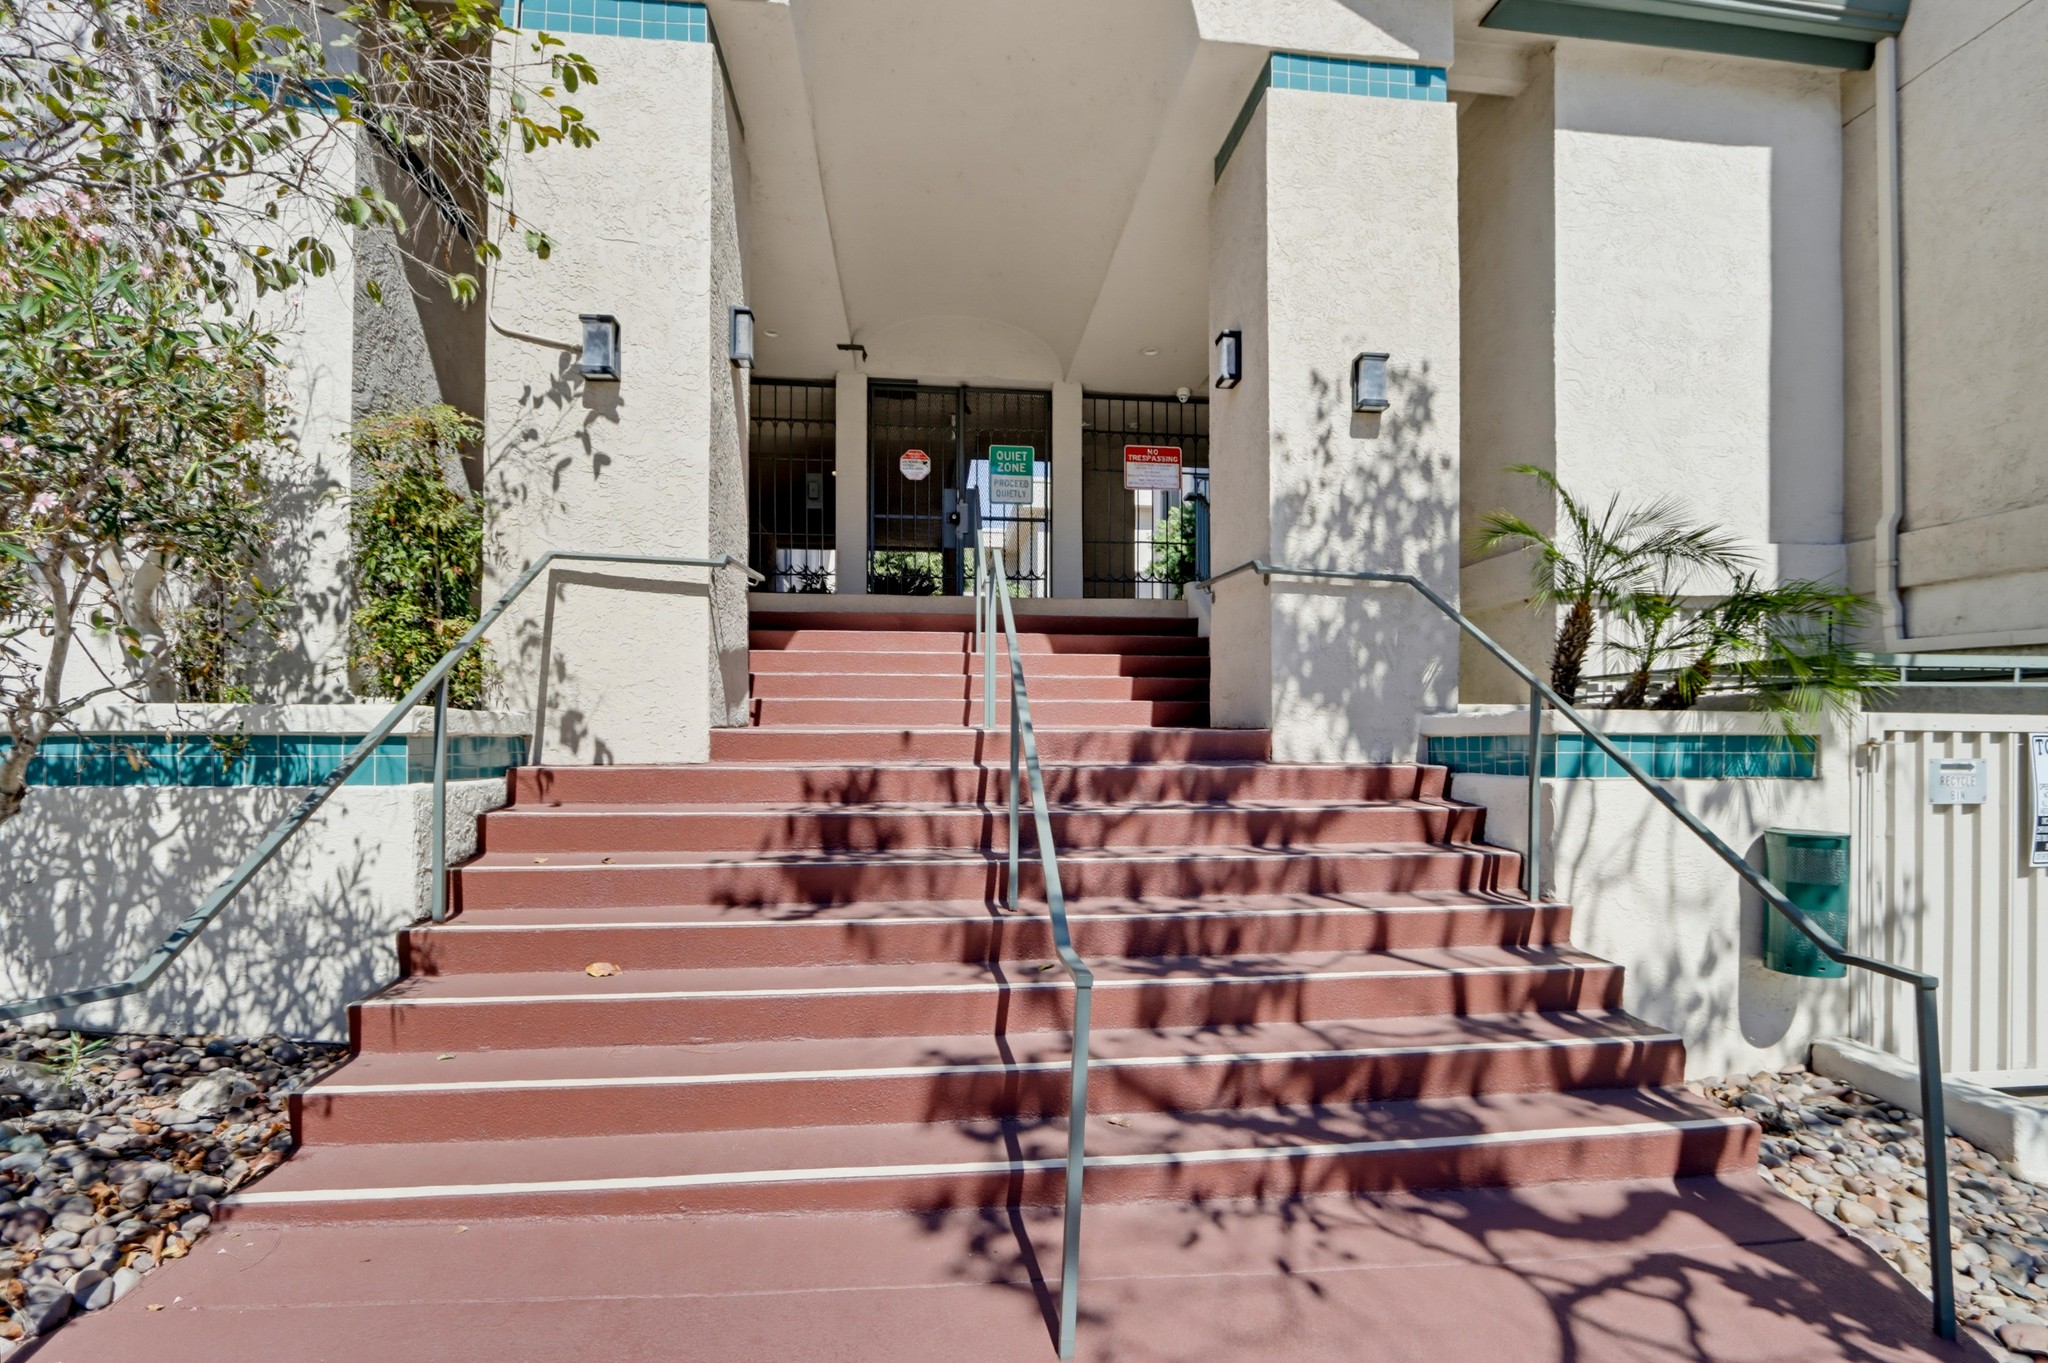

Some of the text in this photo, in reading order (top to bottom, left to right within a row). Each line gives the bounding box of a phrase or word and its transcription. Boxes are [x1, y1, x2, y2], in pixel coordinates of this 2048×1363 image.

[996, 450, 1028, 461] QUIET
[1147, 448, 1159, 456] NO
[1127, 454, 1179, 463] TRESPASSING
[997, 462, 1027, 473] ZONE
[994, 479, 1029, 489] PROCEED
[995, 489, 1027, 499] QUIETLY
[1940, 775, 1976, 787] RECYCLE
